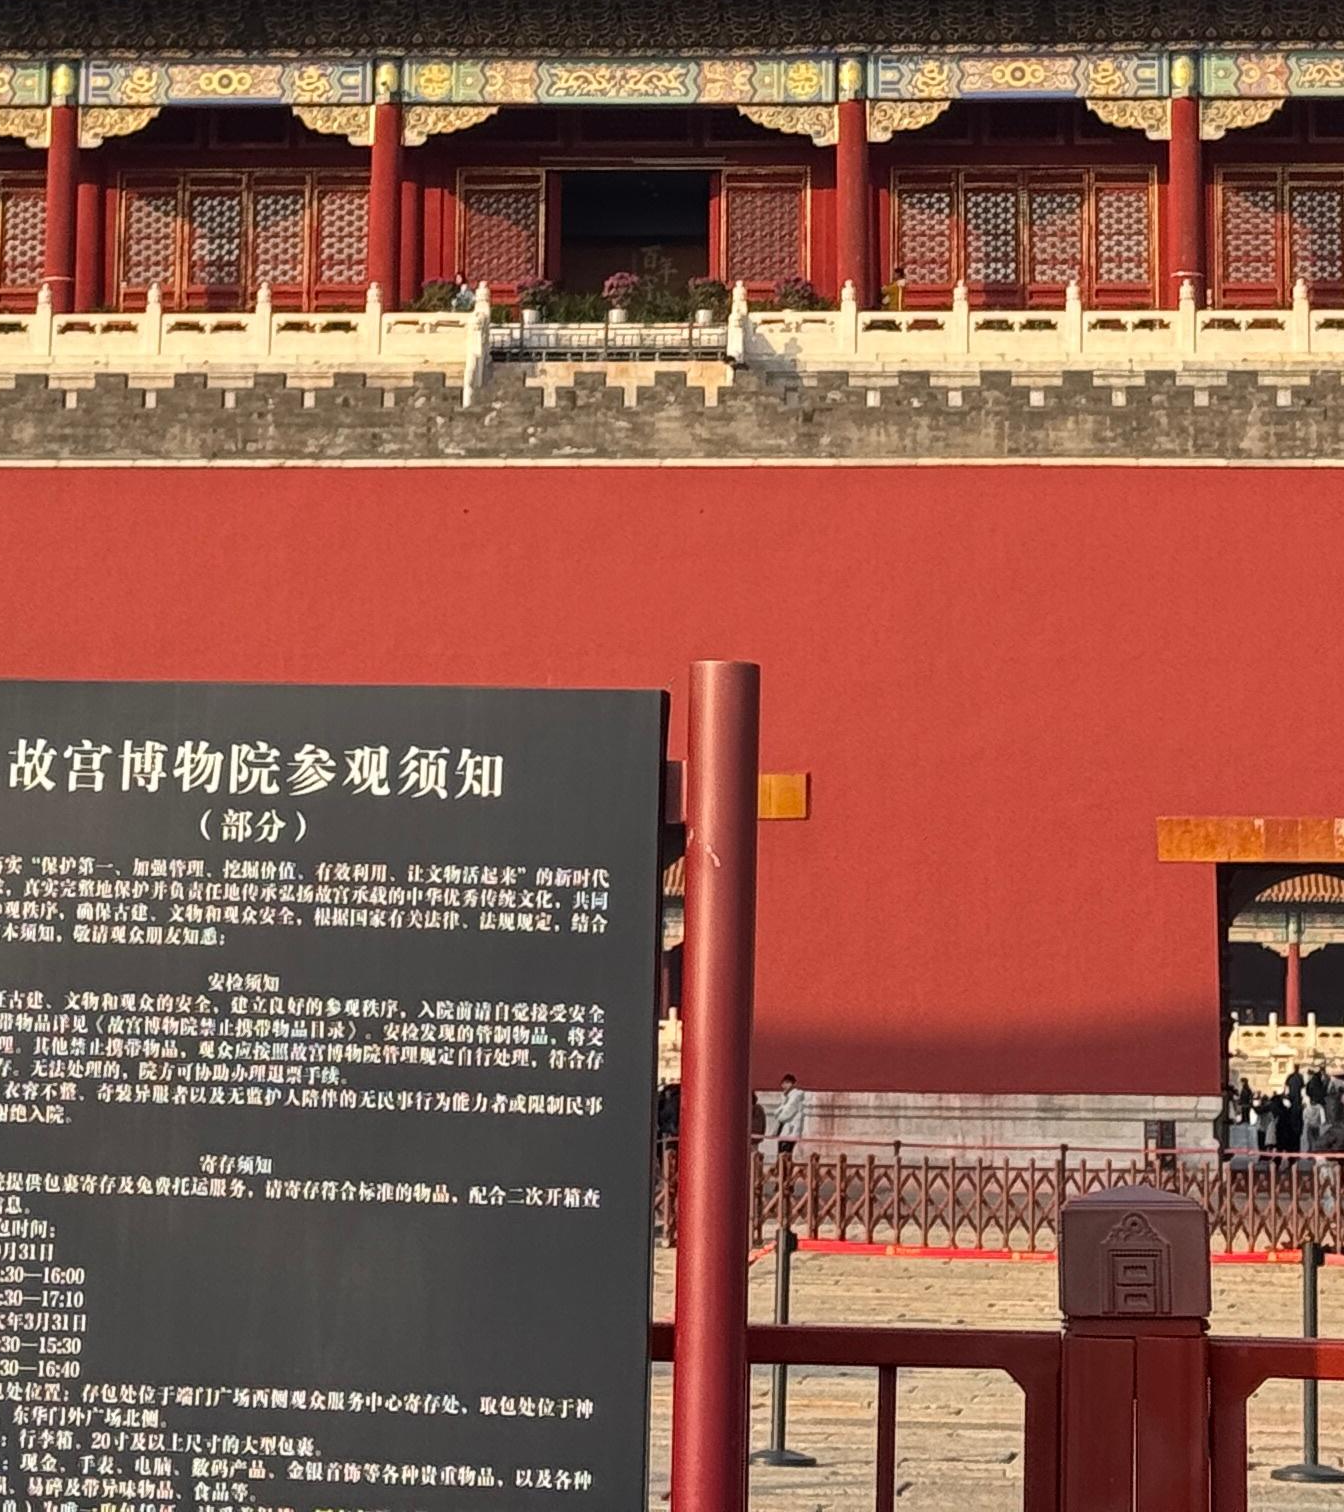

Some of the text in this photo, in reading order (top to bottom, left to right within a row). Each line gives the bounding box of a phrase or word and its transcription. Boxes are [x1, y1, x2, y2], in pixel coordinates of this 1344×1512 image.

[8, 738, 503, 799] 故宫博物院参观须知
[208, 973, 279, 993] 安检须知
[200, 1155, 272, 1175] 寄存须知
